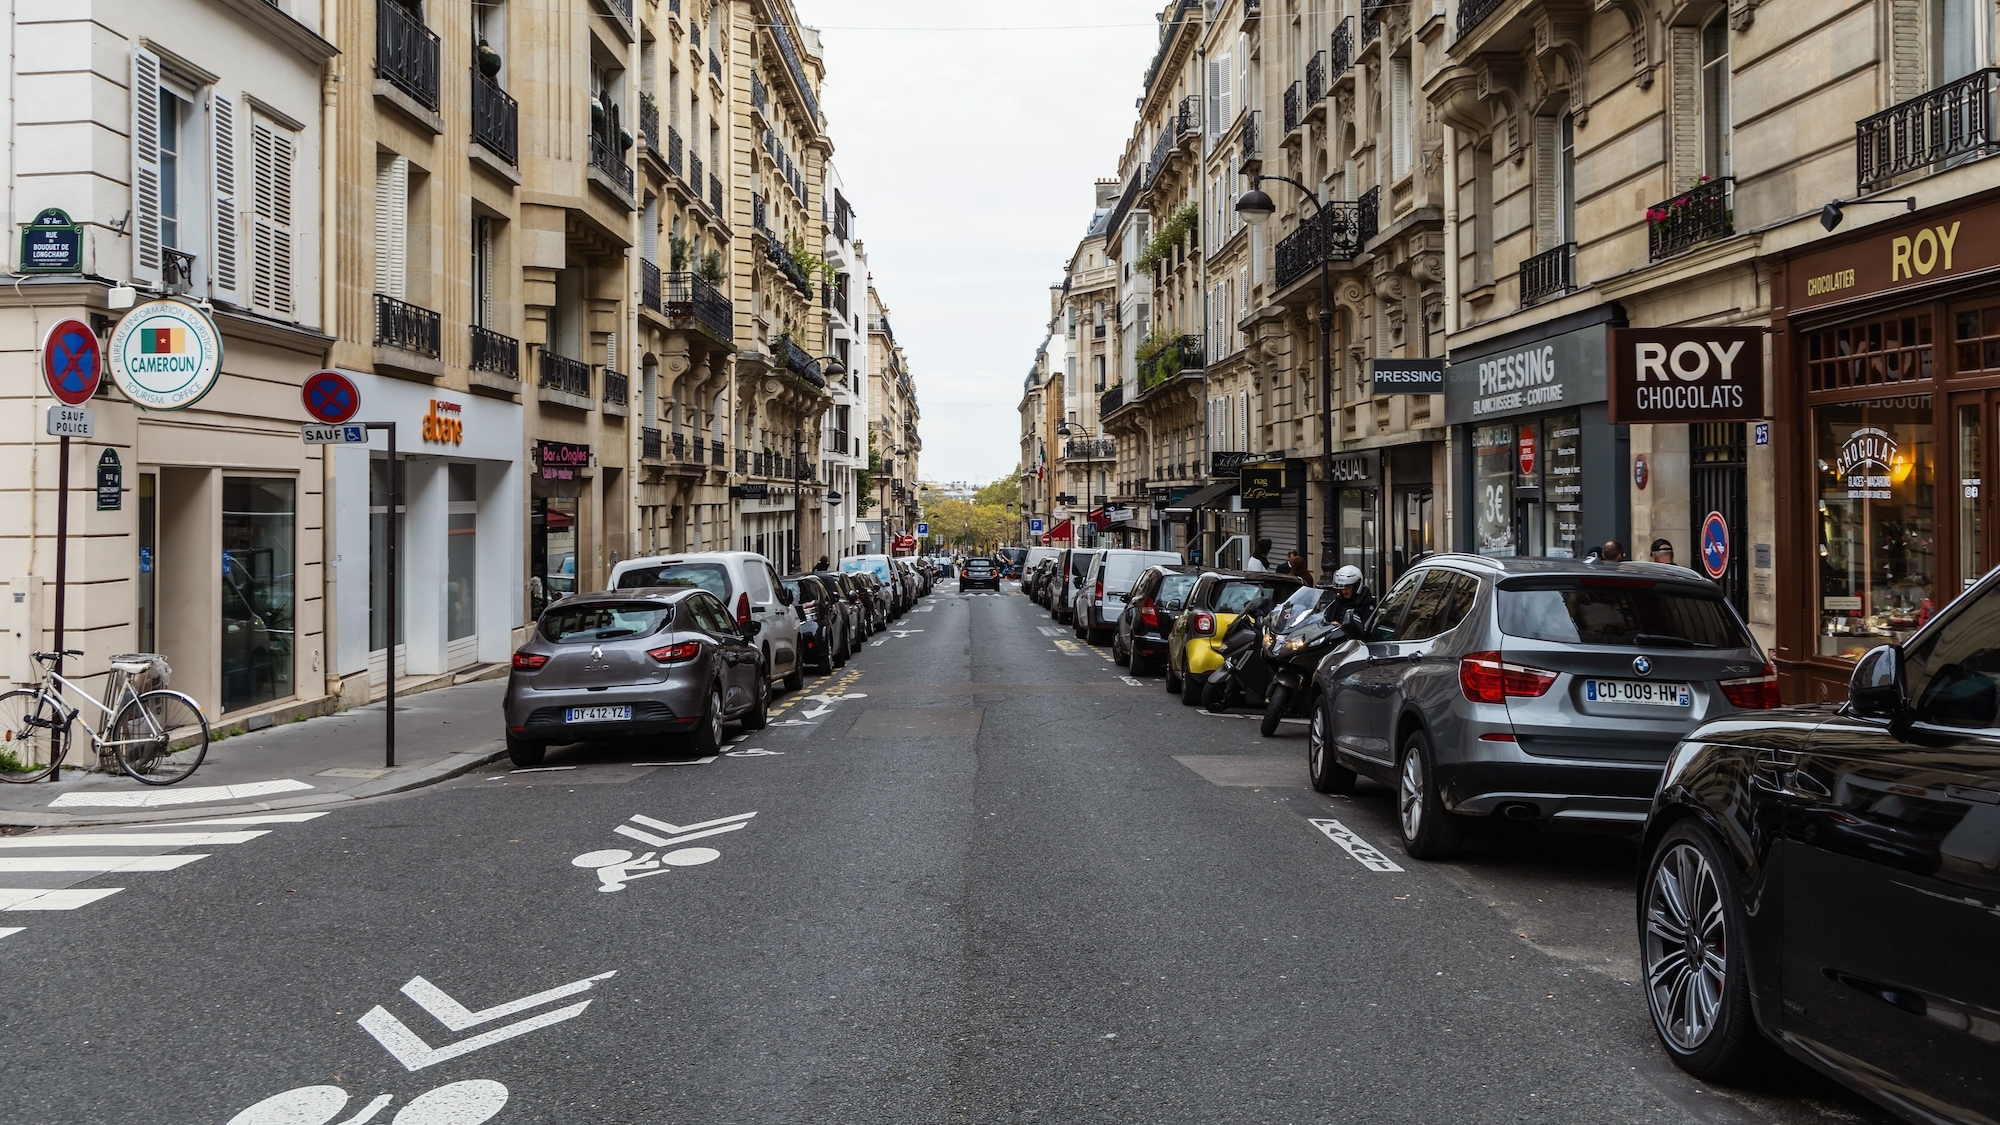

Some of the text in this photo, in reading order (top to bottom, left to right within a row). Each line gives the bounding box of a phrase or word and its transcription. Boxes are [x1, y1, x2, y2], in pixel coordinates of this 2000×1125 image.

[1807, 220, 1961, 297] CHOCOLATIER ROY
[113, 305, 213, 363] BUREAU d'INFORMATION TOURISTIQUE
[131, 356, 195, 373] CAMEROUN
[1479, 345, 1555, 397] PRESSING
[1636, 341, 1745, 382] ROY
[1374, 370, 1442, 383] PRESSING
[125, 381, 203, 404] TOURISM OFFICE
[1473, 392, 1522, 415] BLANCHISSERIE
[1527, 384, 1563, 406] COUTURE
[1637, 384, 1744, 410] CHOCOLATS
[61, 411, 84, 421] SAUF
[56, 422, 88, 433] POLICE
[305, 430, 341, 441] SAUF
[1472, 427, 1512, 447] BLANC BLEU
[1756, 425, 1768, 443] 25
[543, 446, 555, 461] Bar
[561, 446, 587, 466] Ongles
[1837, 438, 1904, 475] CHOCOLATS
[1253, 477, 1268, 486] nag
[1848, 476, 1864, 487] GLACES
[1867, 476, 1891, 487] MACARONS
[1486, 484, 1504, 524] 3€
[1033, 521, 1039, 530] P
[1720, 664, 1751, 674] X3
[1597, 682, 1678, 702] CD-009-HW
[1680, 695, 1688, 705] 75
[573, 707, 624, 720] DY-412-YZ
